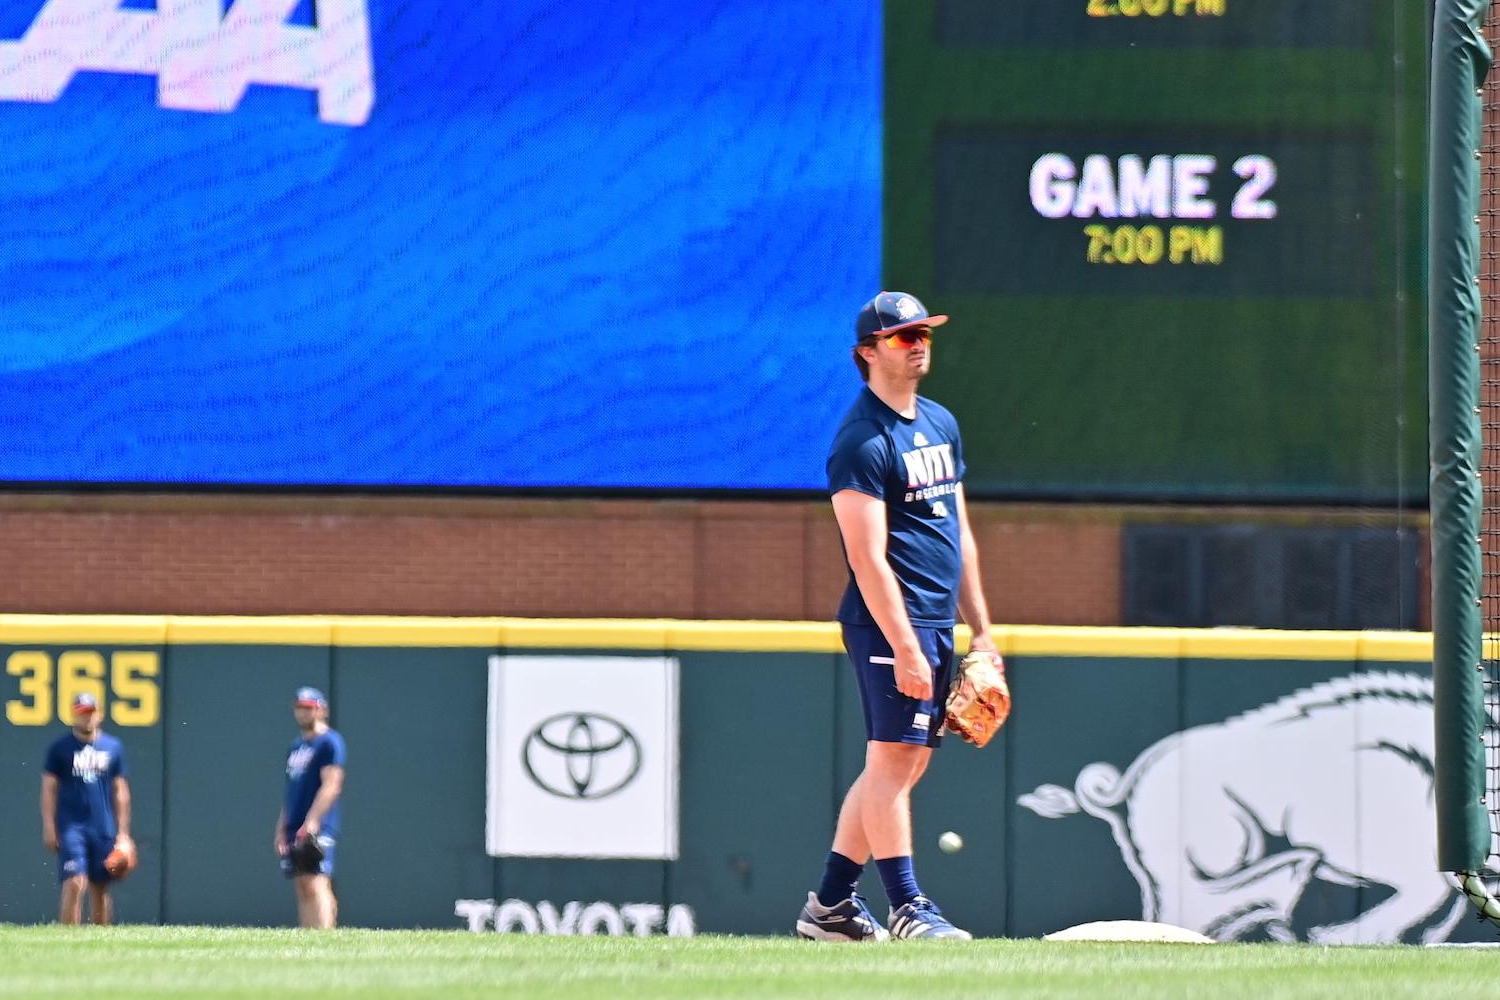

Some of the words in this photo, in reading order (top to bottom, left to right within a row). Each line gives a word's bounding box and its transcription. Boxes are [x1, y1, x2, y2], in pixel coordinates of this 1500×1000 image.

[1028, 151, 1217, 220] GAME
[1230, 153, 1278, 220] 2
[1083, 224, 1160, 266] 7:00
[1168, 224, 1223, 265] PM
[6, 650, 160, 727] 365
[453, 898, 695, 936] TOYOTA
